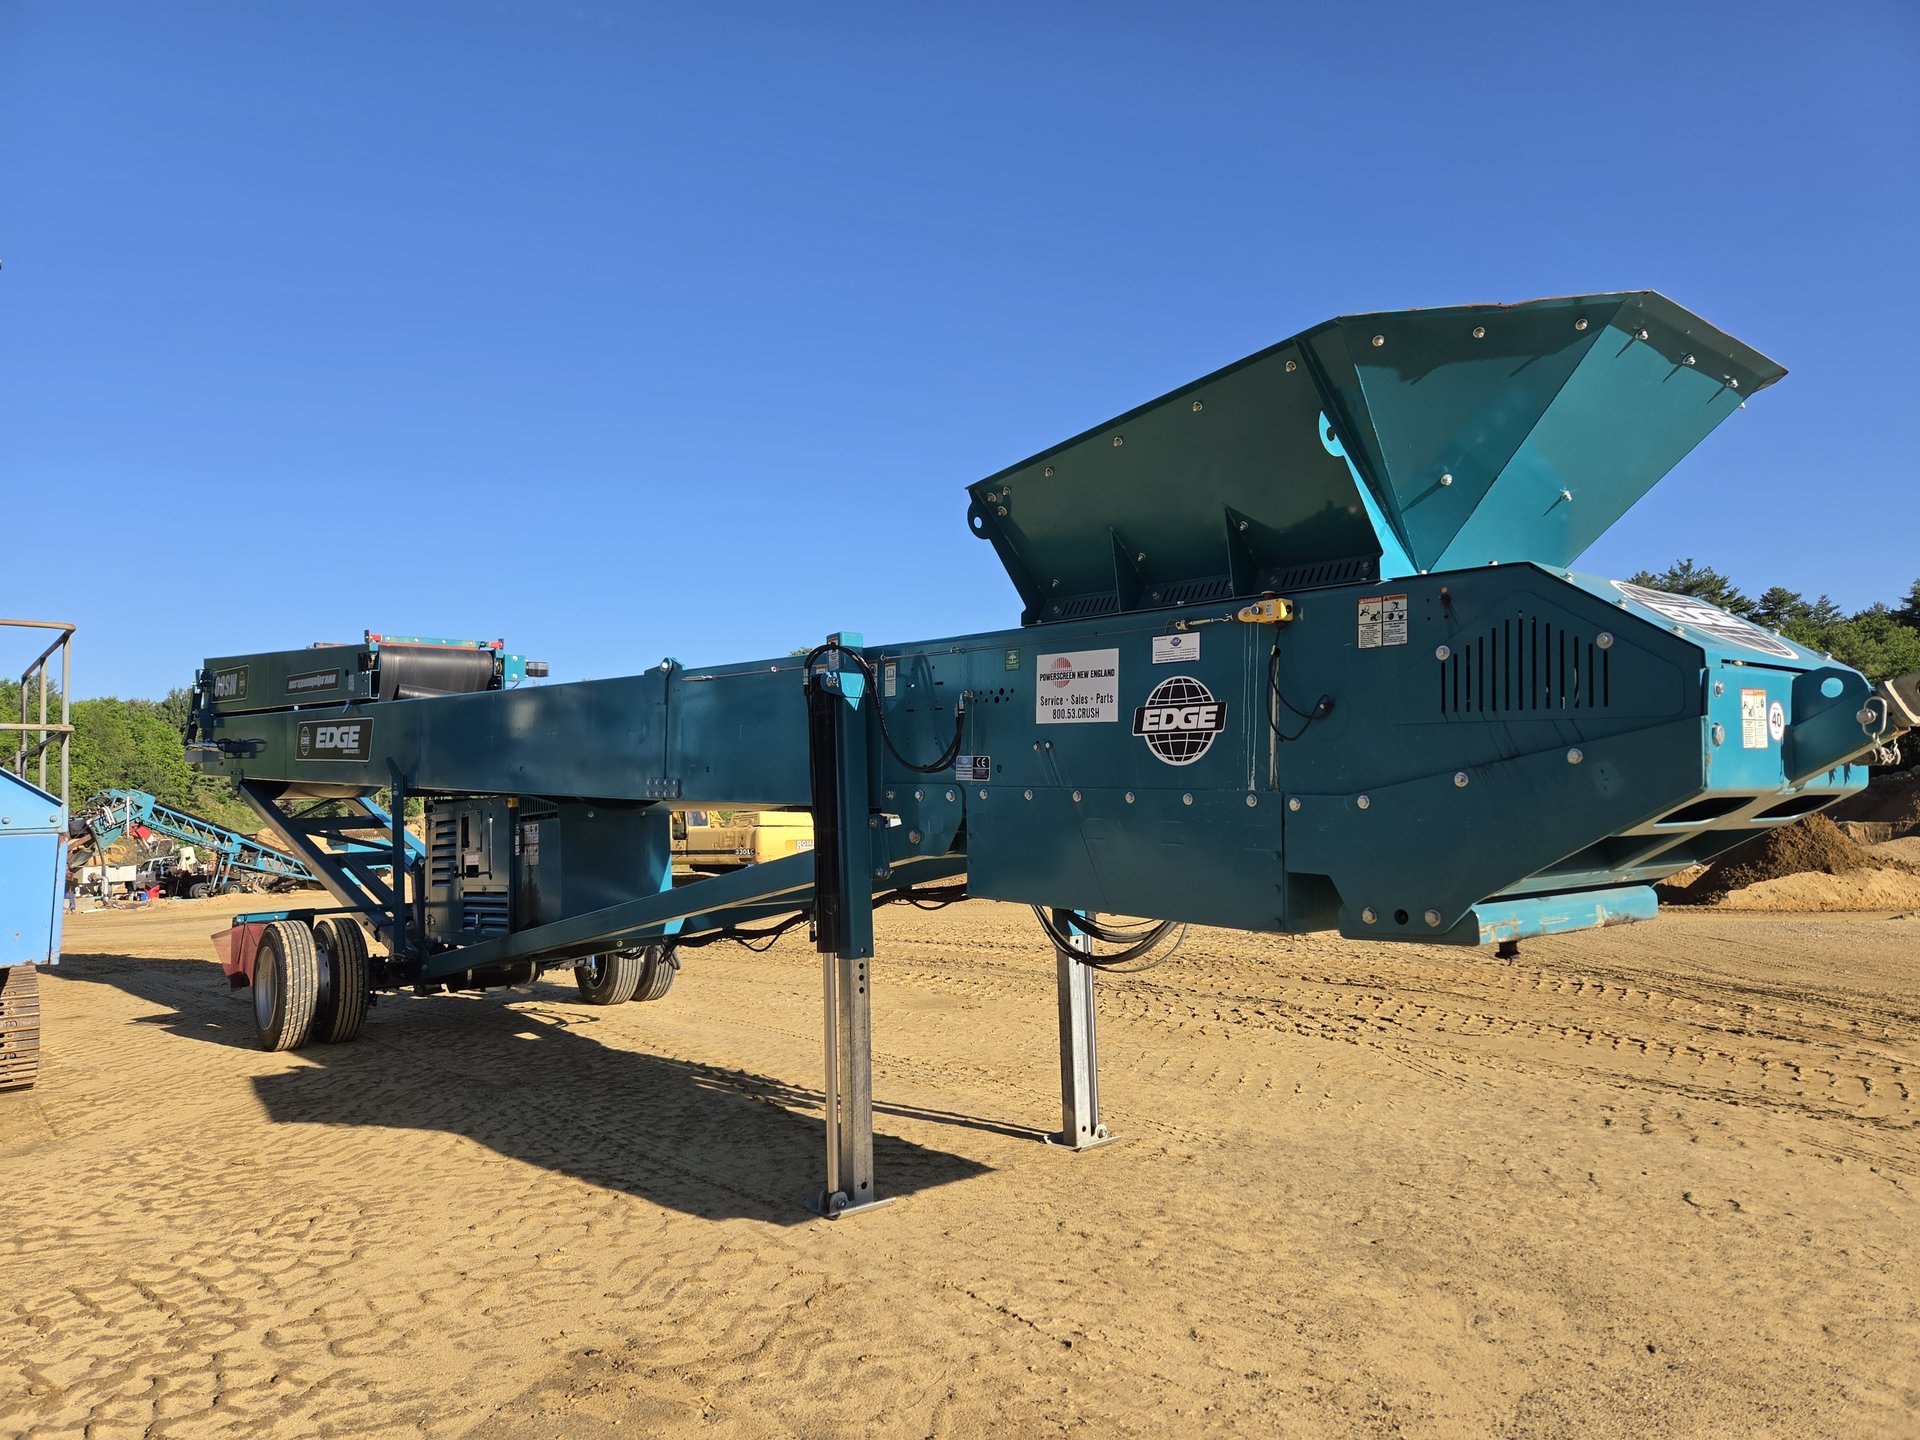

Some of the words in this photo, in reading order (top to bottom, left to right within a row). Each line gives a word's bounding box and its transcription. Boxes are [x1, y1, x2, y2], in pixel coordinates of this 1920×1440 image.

[1641, 601, 1753, 629] EDGE
[1039, 671, 1076, 681] POWERSCREEN
[1077, 670, 1089, 679] NEW
[1090, 668, 1115, 678] ENGLAND
[1040, 695, 1063, 706] Service
[1070, 693, 1088, 705] Sales
[1096, 692, 1114, 704] Parts
[1052, 707, 1100, 720] 800.53.CRUSH
[1142, 705, 1218, 732] EDGE
[1772, 712, 1782, 727] 40
[315, 725, 361, 748] EDGE
